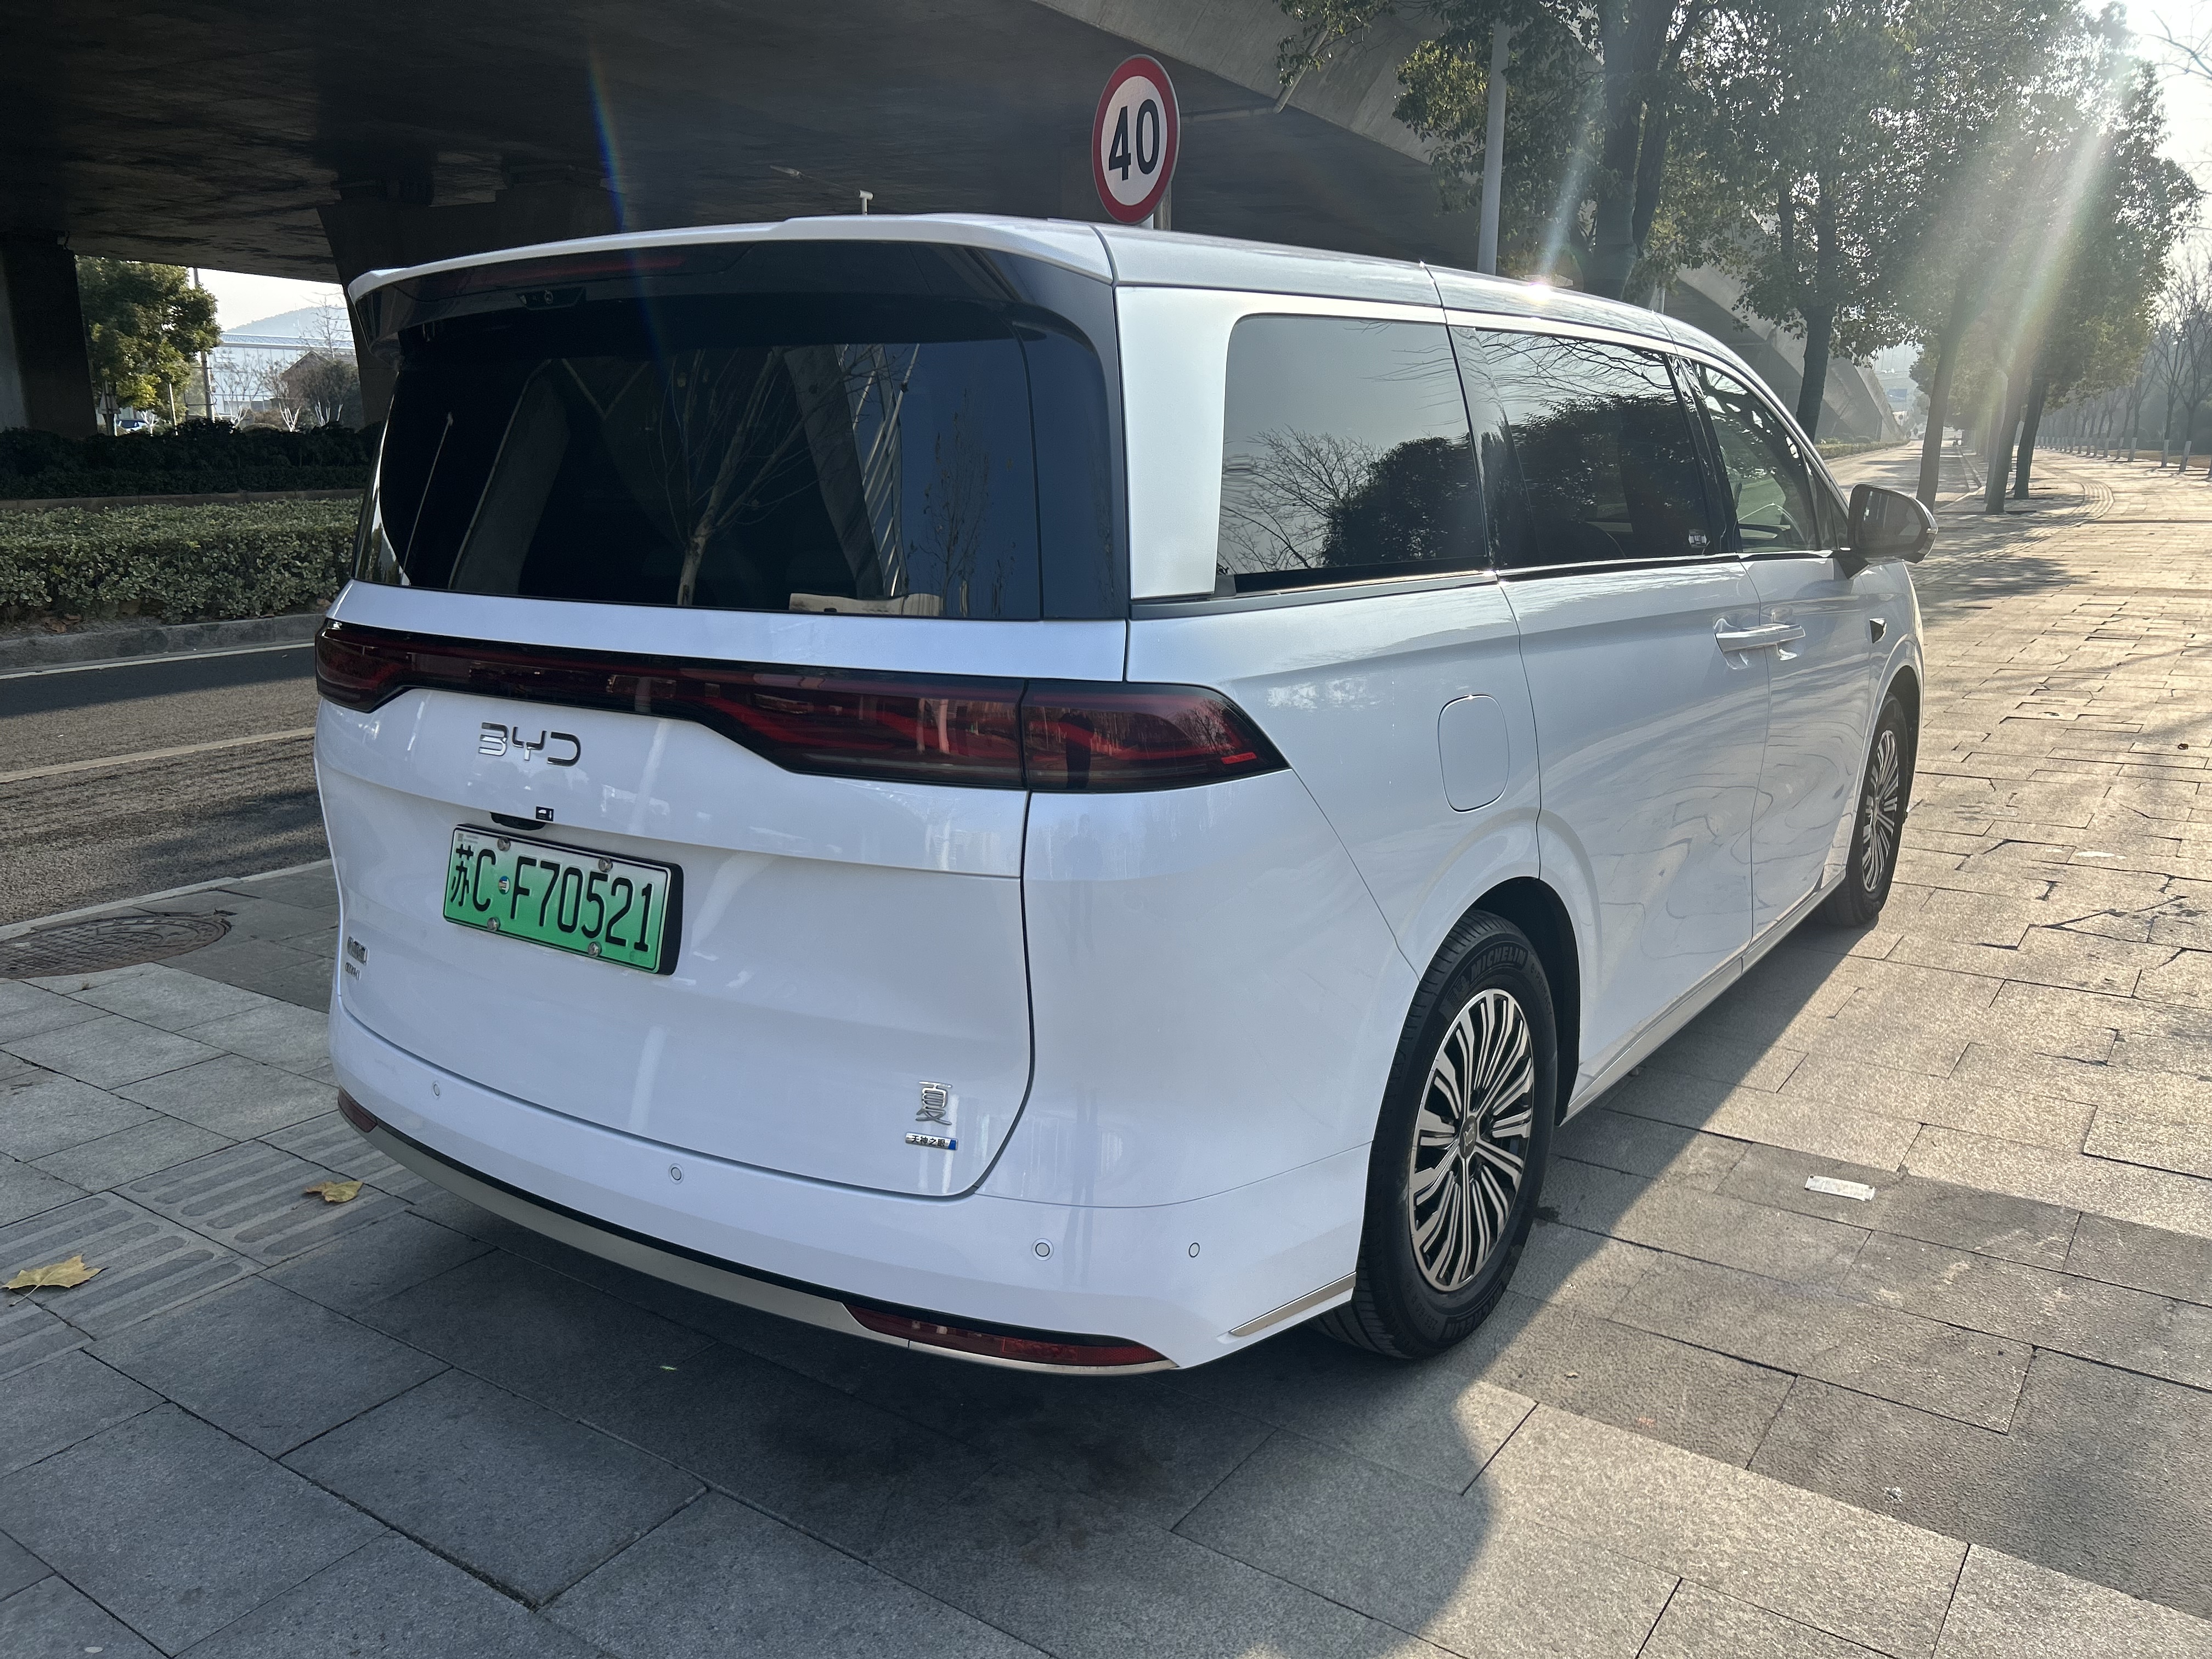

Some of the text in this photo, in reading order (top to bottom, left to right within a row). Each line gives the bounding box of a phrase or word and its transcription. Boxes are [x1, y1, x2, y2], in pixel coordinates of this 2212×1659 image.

[1109, 99, 1160, 181] 40
[478, 722, 581, 766] BYD
[1471, 946, 1526, 981] MICHELIN
[916, 1081, 953, 1125] 夏
[911, 1135, 945, 1148] 天神之眼
